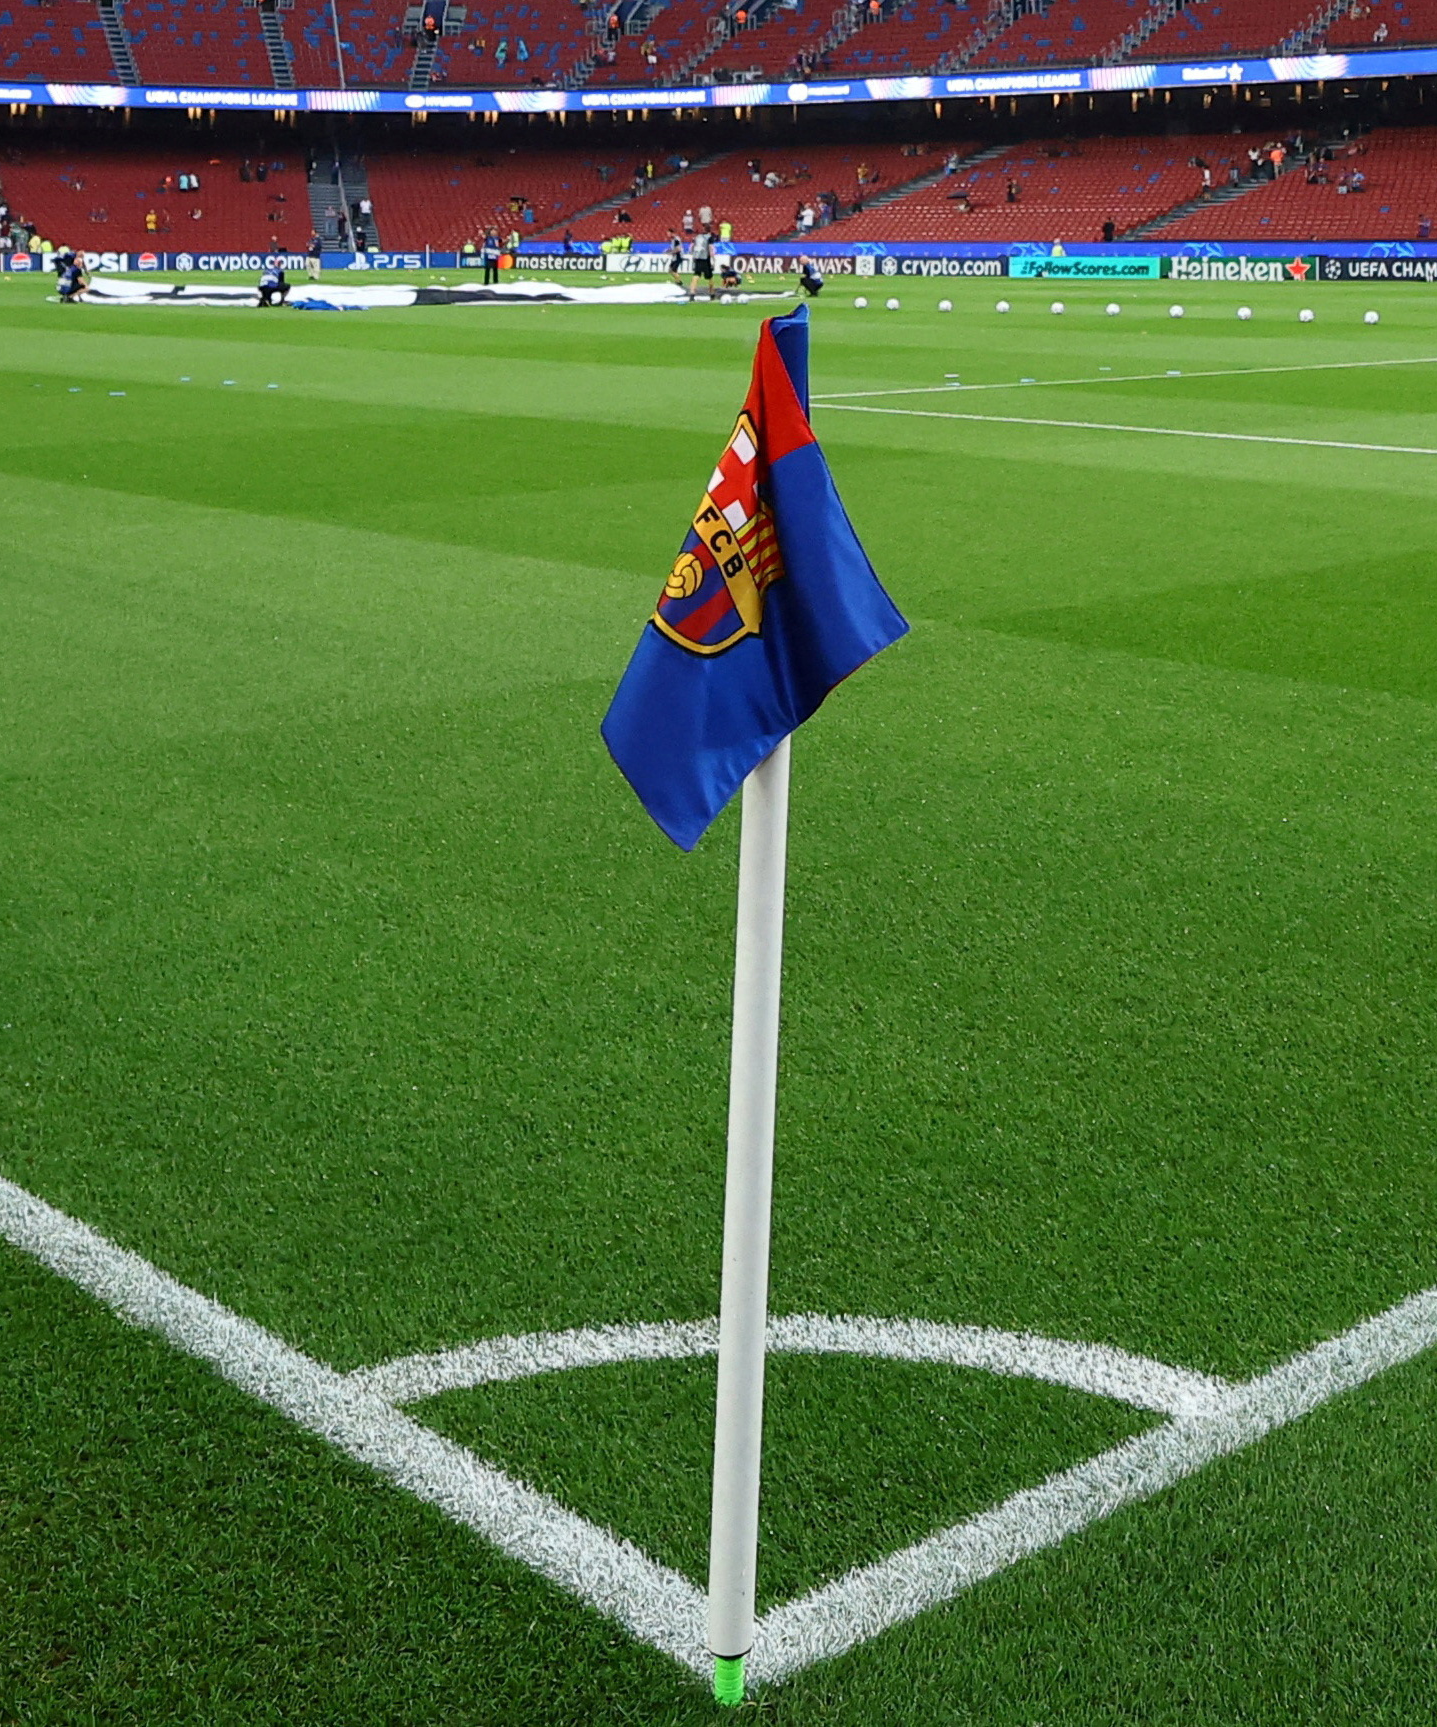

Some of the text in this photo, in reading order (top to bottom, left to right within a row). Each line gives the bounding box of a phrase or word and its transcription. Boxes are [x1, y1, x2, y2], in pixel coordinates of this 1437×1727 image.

[198, 253, 304, 271] crypto.com
[373, 254, 421, 269] PS5
[516, 254, 604, 270] mastercard
[734, 257, 783, 273] QATAR
[902, 257, 1001, 277] crypto.com
[1169, 256, 1285, 281] Heineken
[1349, 262, 1388, 277] UEFA
[695, 505, 744, 578] FCB
